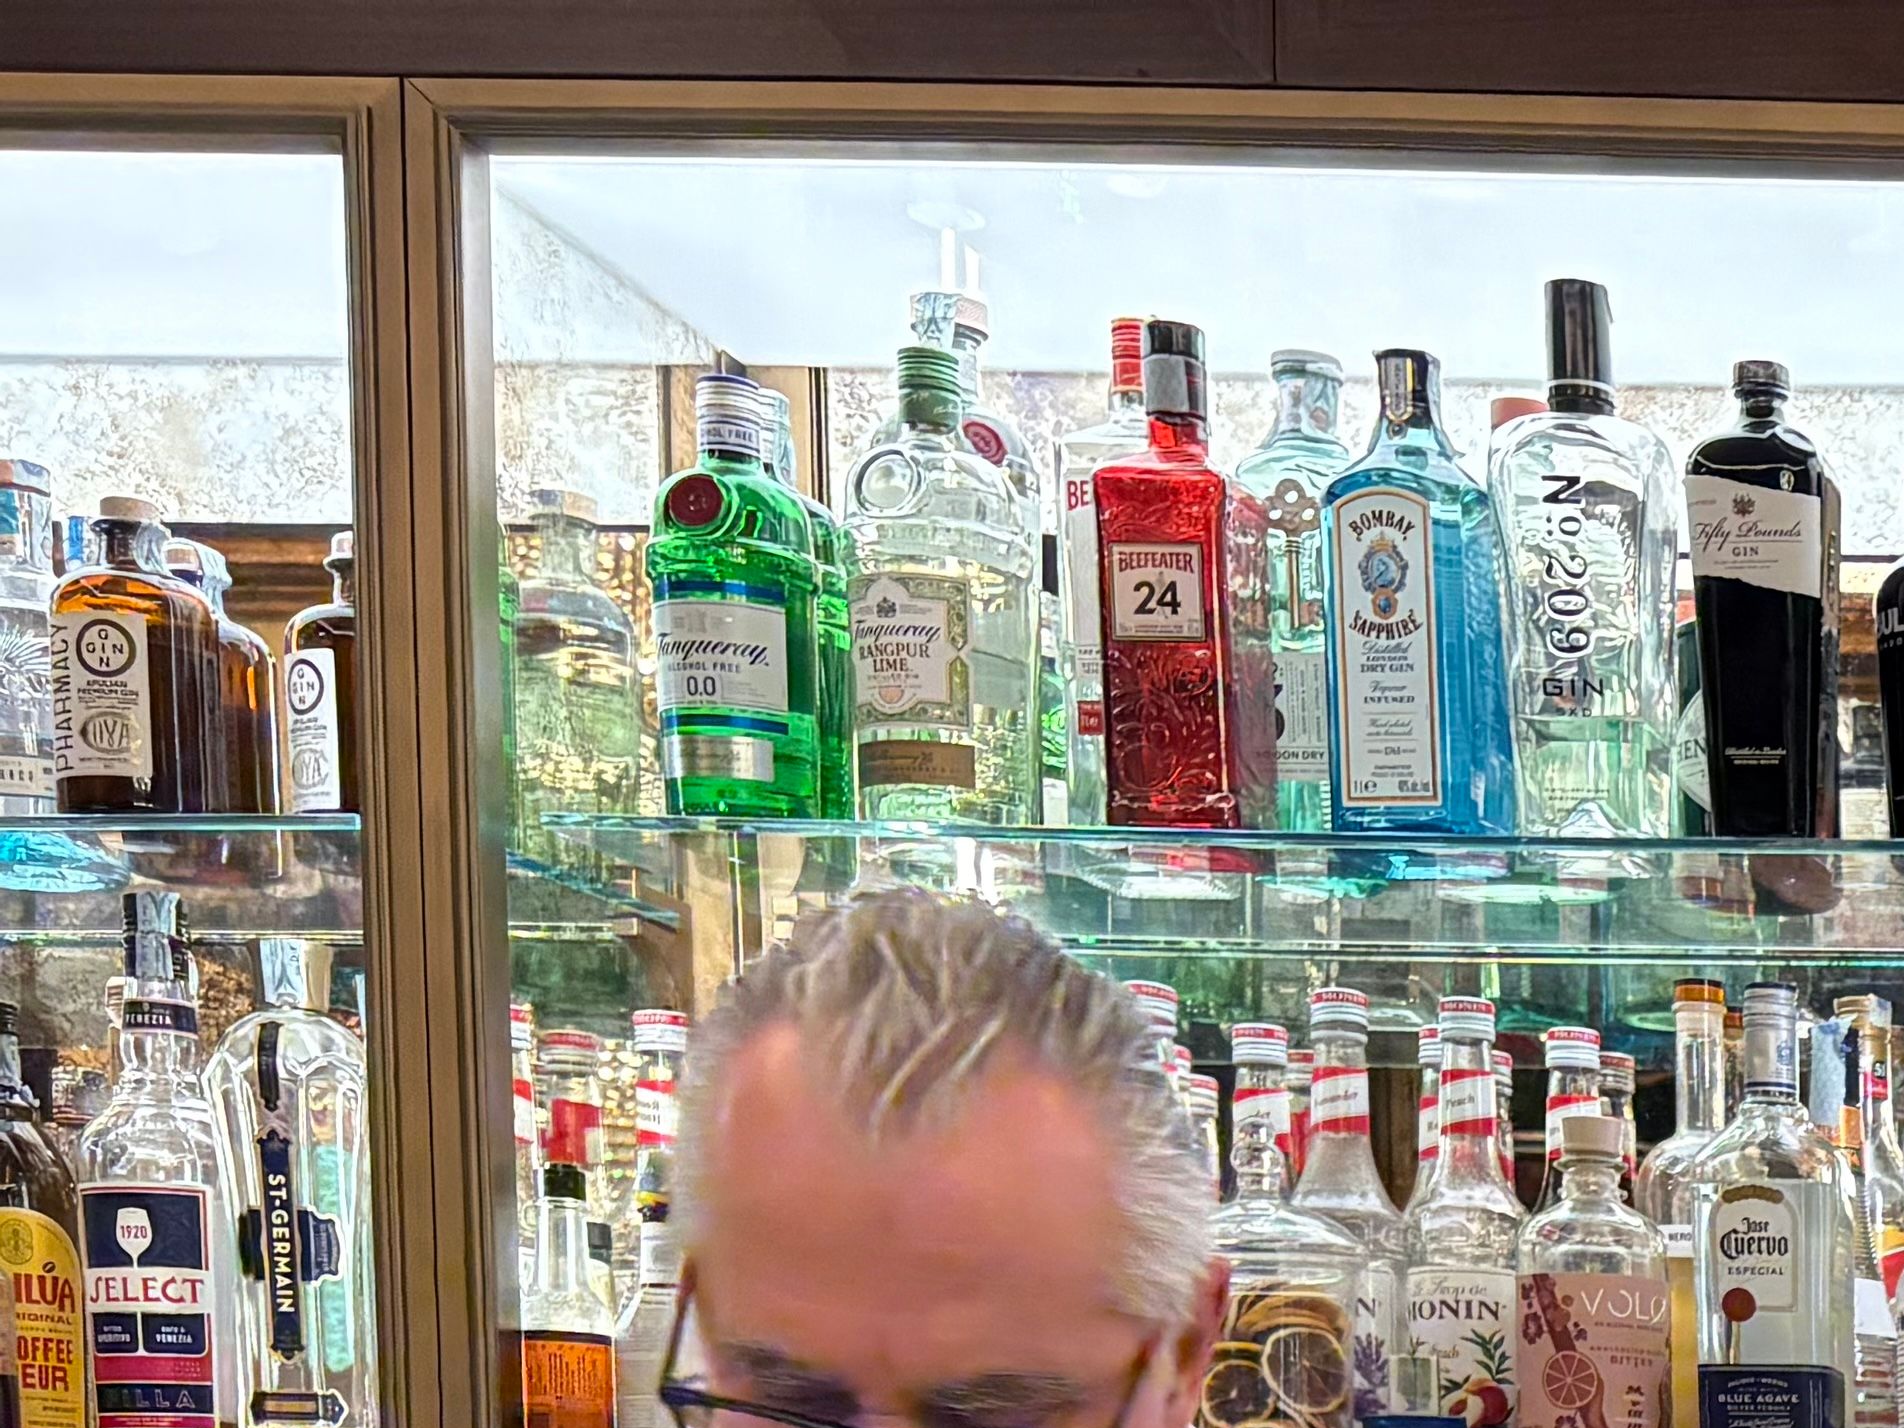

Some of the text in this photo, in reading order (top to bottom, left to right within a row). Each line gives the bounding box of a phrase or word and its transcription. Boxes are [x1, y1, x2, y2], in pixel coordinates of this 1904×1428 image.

[1348, 509, 1416, 537] BOMBAY
[1694, 516, 1802, 553] Fifty Pounds
[1118, 551, 1194, 574] BEEFEATER
[1732, 546, 1760, 558] GIN
[1133, 580, 1182, 616] 24
[1349, 609, 1423, 641] SAPPHIRE
[859, 643, 931, 661] RANGPUR
[872, 658, 909, 673] LIME
[1360, 663, 1415, 673] DRY GIN
[686, 675, 716, 697] 0.0
[1542, 677, 1605, 698] GIN
[51, 624, 74, 773] PHARMACY
[1302, 750, 1325, 761] DRY
[120, 1224, 149, 1240] 1920
[268, 1173, 296, 1314] ST-GERMAIN
[1719, 1228, 1790, 1260] Cuervo
[1727, 1265, 1786, 1277] ESPECIAL
[90, 1275, 204, 1305] SELECT
[17, 1335, 74, 1365] OFFEE
[1718, 1393, 1800, 1404] BLUE AGAVE
